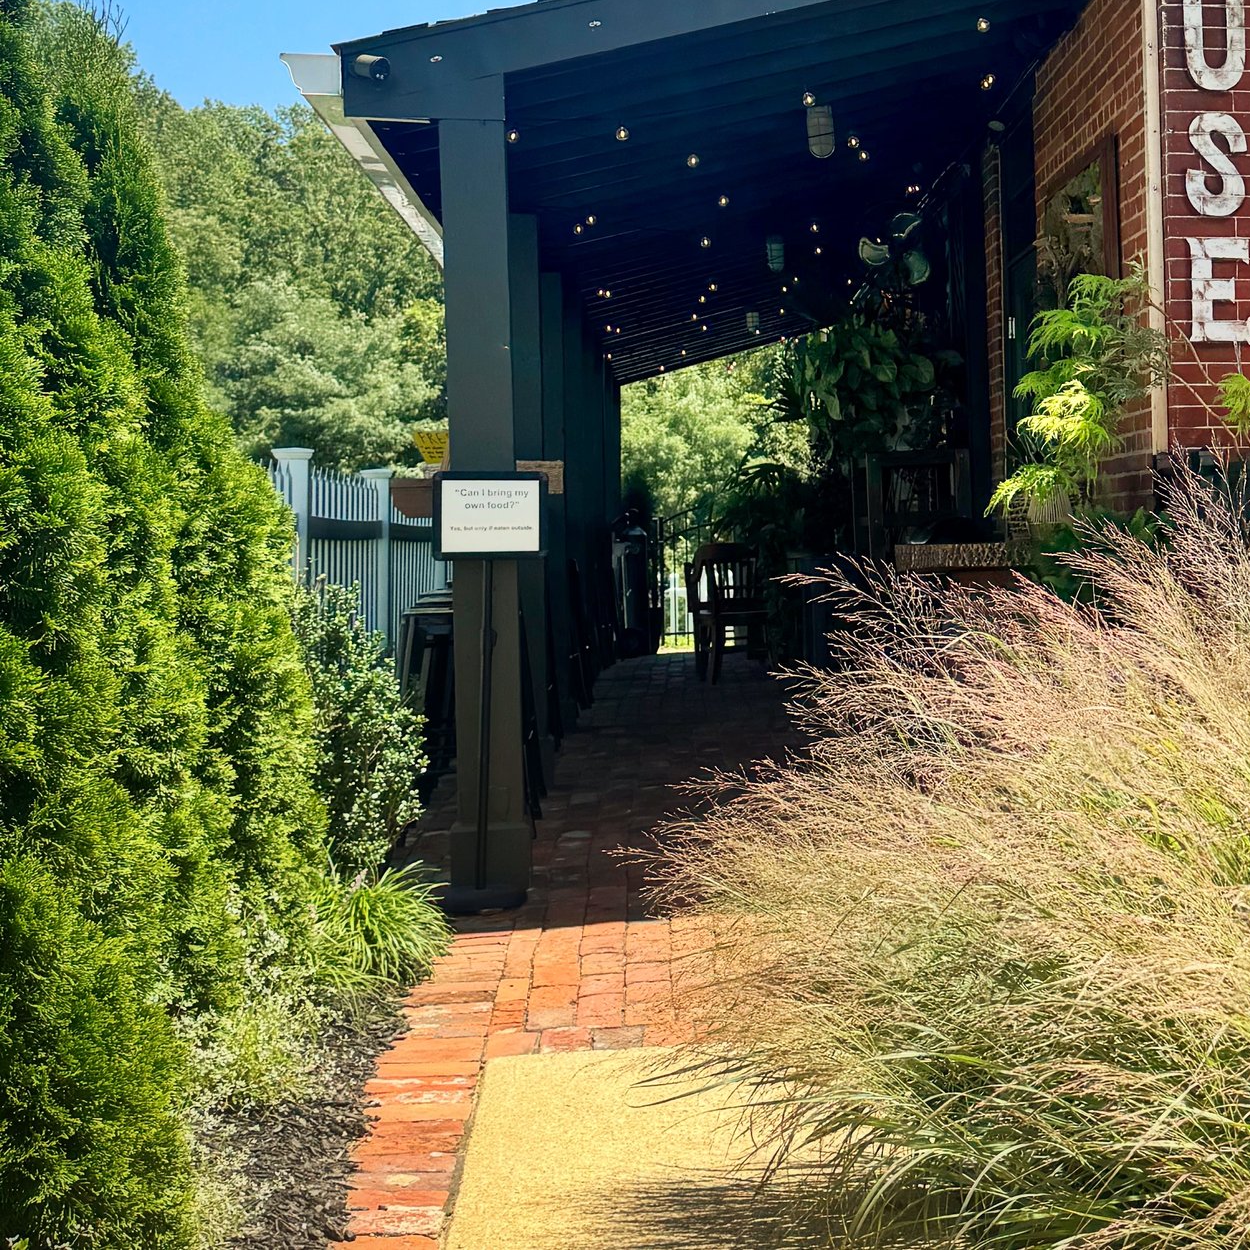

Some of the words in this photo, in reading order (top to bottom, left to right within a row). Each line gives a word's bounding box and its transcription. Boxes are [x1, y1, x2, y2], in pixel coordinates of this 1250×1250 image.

[417, 431, 449, 446] FRE
[487, 488, 512, 498] bring
[514, 490, 529, 498] my
[464, 502, 485, 510] own
